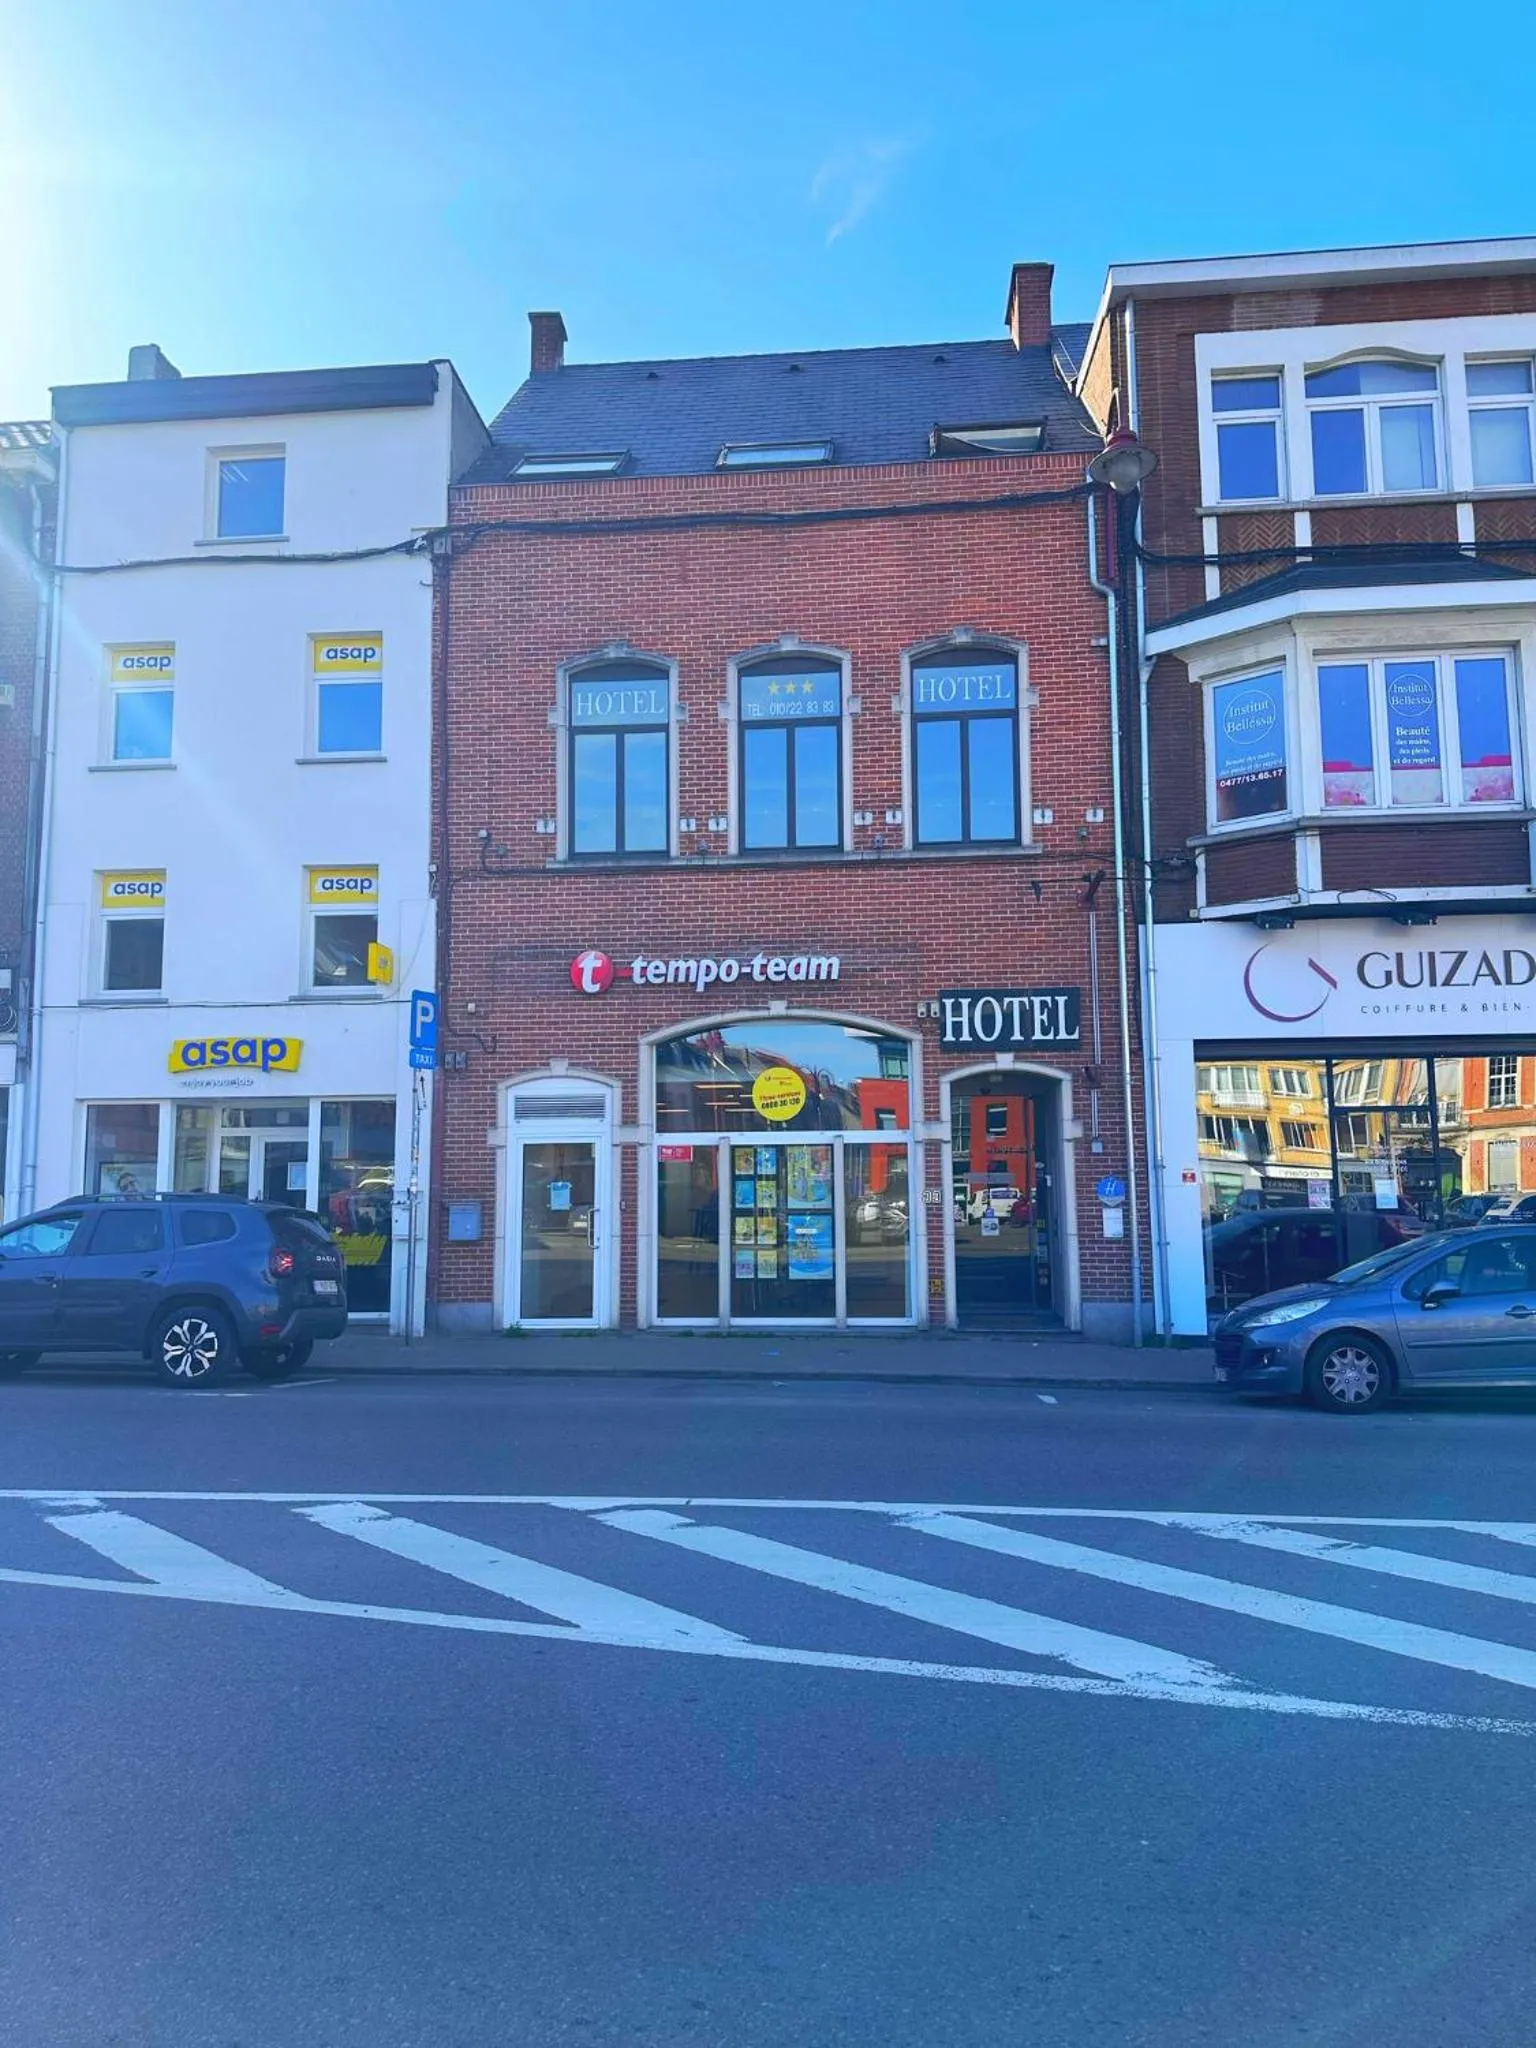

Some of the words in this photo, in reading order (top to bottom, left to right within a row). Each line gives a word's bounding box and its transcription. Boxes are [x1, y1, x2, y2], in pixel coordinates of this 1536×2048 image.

[326, 647, 376, 662] asap
[123, 655, 171, 671] asap
[919, 674, 1011, 702] HOTEL
[1393, 683, 1428, 693] Institut
[576, 689, 665, 715] HOTEL
[1229, 700, 1270, 717] Institut
[114, 882, 162, 898] asap
[322, 878, 372, 894] asap
[631, 952, 840, 992] tempo-team
[1360, 1003, 1448, 1014] COIFFURE
[1460, 1003, 1469, 1012] &
[415, 1000, 434, 1038] P
[942, 996, 1080, 1042] HOTEL
[181, 1038, 288, 1072] asap
[415, 1053, 432, 1065] TAXI
